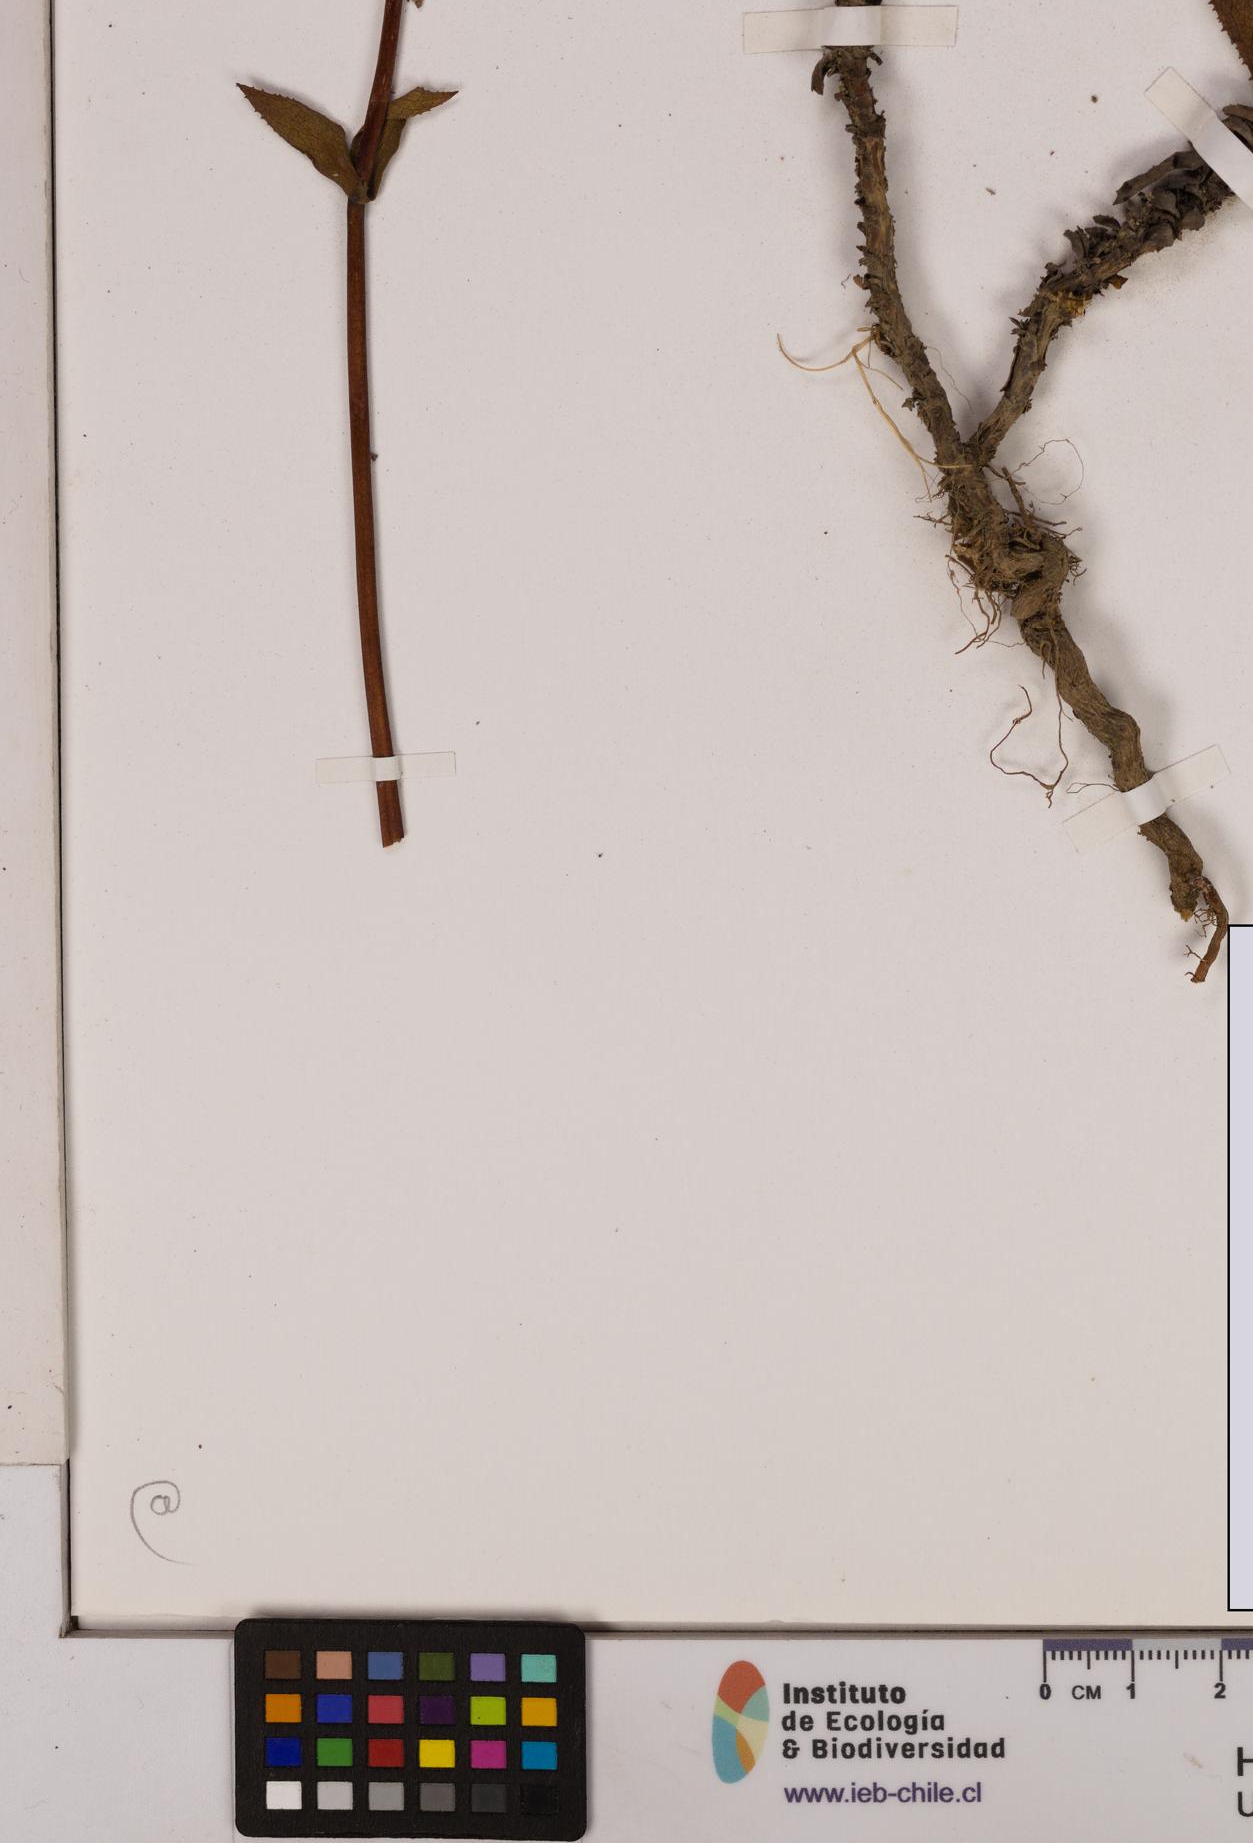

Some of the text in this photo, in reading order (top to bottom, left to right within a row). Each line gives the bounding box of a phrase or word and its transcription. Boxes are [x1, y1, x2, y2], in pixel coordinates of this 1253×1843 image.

[783, 1680, 907, 1705] Instituto
[1039, 1681, 1052, 1701] 0
[1071, 1684, 1102, 1701] CM
[1125, 1680, 1136, 1700] 1
[1213, 1680, 1227, 1700] 2
[781, 1709, 945, 1735] de Ecología
[782, 1736, 1005, 1760] & Biodiversidad
[783, 1781, 982, 1804] www.ieb-chile.cl
